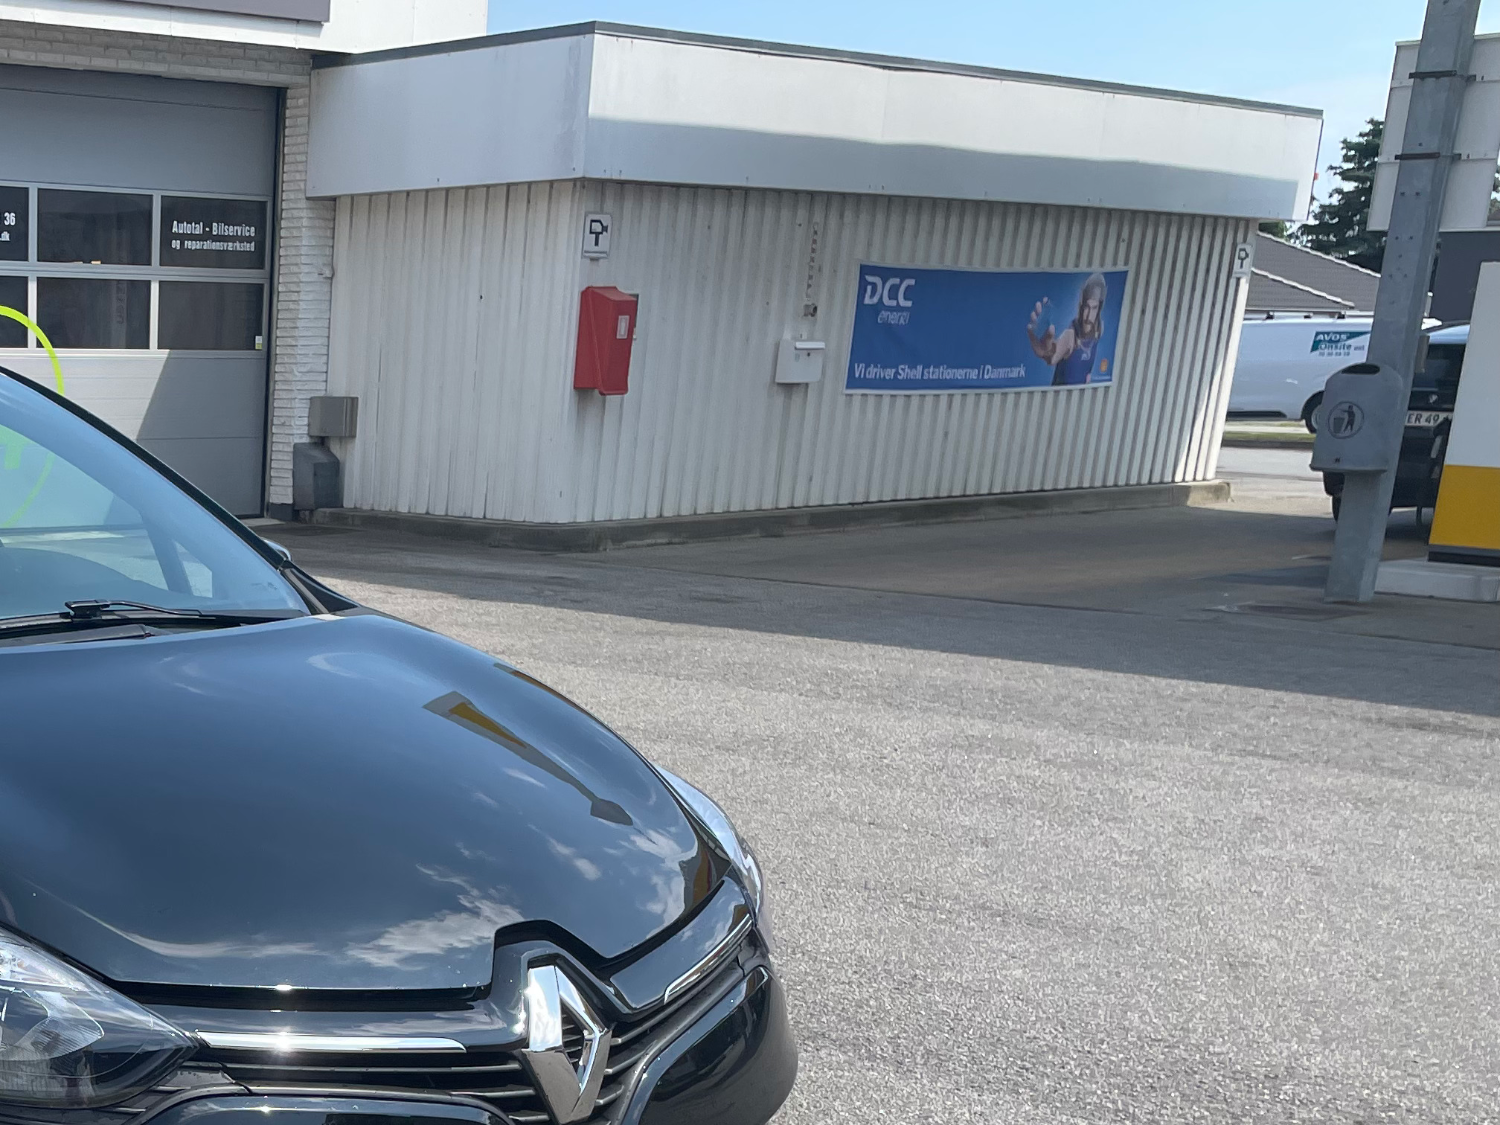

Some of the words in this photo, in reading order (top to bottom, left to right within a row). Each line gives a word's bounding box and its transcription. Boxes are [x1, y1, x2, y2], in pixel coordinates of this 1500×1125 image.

[4, 212, 16, 226] 36
[172, 220, 203, 235] Autotal
[212, 222, 255, 237] Bilservice
[171, 240, 181, 250] og
[184, 240, 255, 252] reparationsværksted
[863, 275, 915, 307] DCC
[854, 363, 865, 378] Vi
[866, 364, 896, 380] driver
[897, 364, 923, 380] Shell
[923, 365, 979, 380] stationerne
[984, 363, 1026, 380] Danmark
